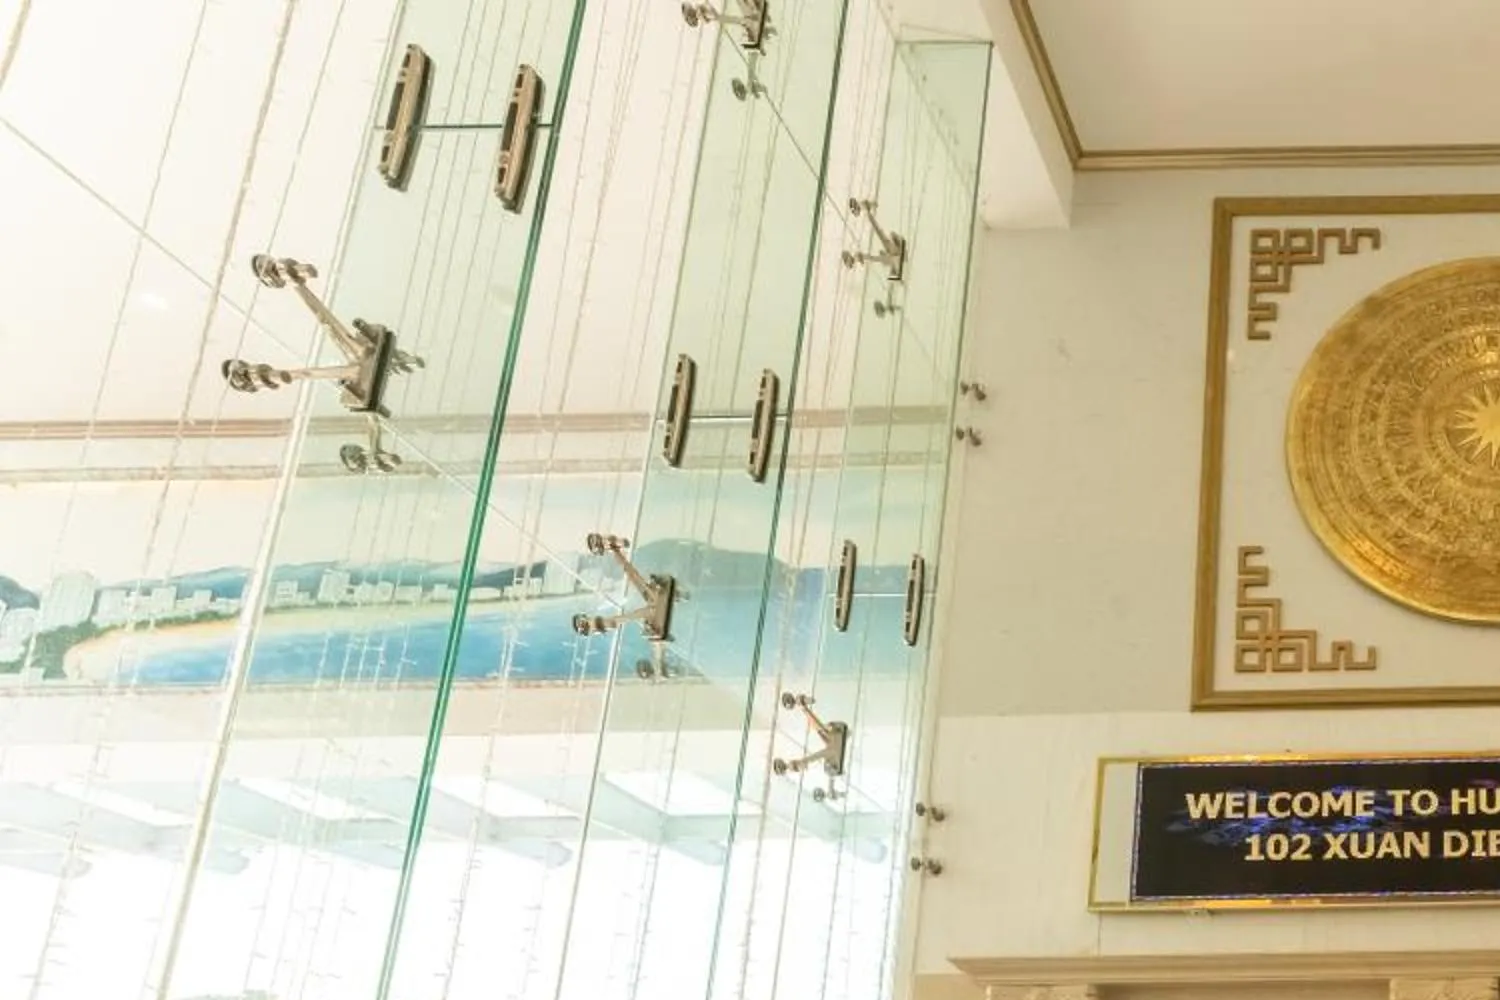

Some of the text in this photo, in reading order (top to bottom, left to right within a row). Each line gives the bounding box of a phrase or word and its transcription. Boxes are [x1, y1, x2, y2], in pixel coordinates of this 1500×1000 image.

[1185, 789, 1376, 820] WELCOME
[1386, 789, 1439, 816] TO
[1244, 833, 1312, 861] 102
[1322, 831, 1435, 860] XUAN
